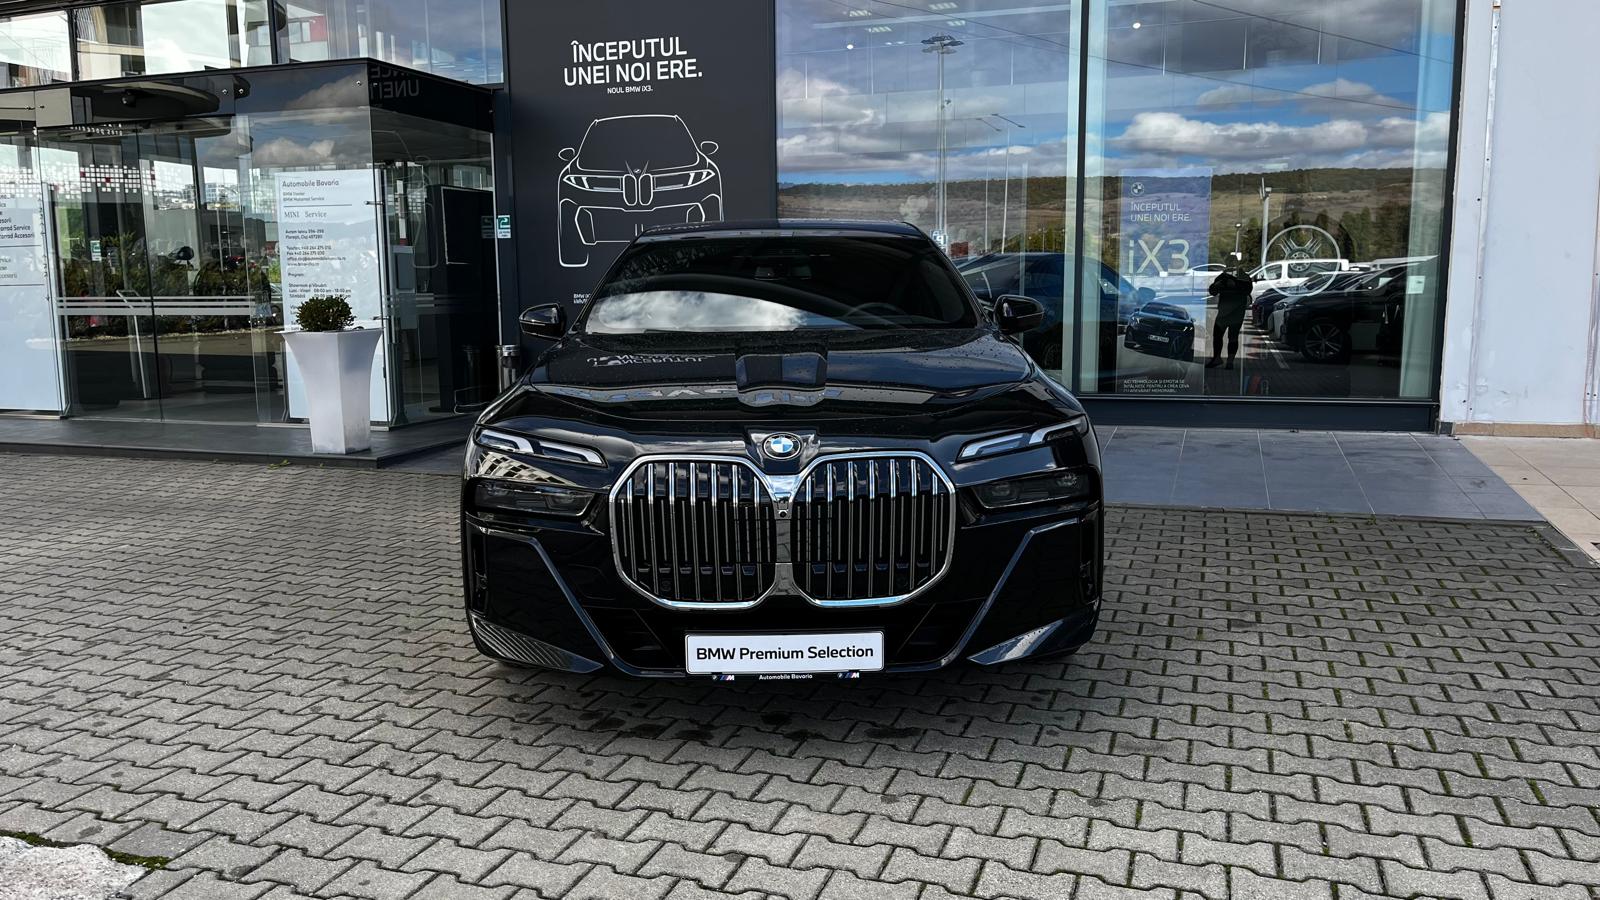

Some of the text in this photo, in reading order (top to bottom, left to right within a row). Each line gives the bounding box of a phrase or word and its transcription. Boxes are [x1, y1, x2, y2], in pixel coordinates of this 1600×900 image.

[571, 36, 688, 63] ÎNCEPUTUL
[564, 58, 703, 86] UNEI NOI ERE.
[607, 86, 625, 94] NOUL
[282, 179, 340, 188] Automobile Bavaria
[1130, 202, 1182, 212] ÎNCEPUTUL
[1130, 213, 1152, 222] UNEI
[1154, 213, 1170, 221] NOI
[1129, 239, 1190, 274] iX3
[696, 645, 874, 660] BMW Premium Selection
